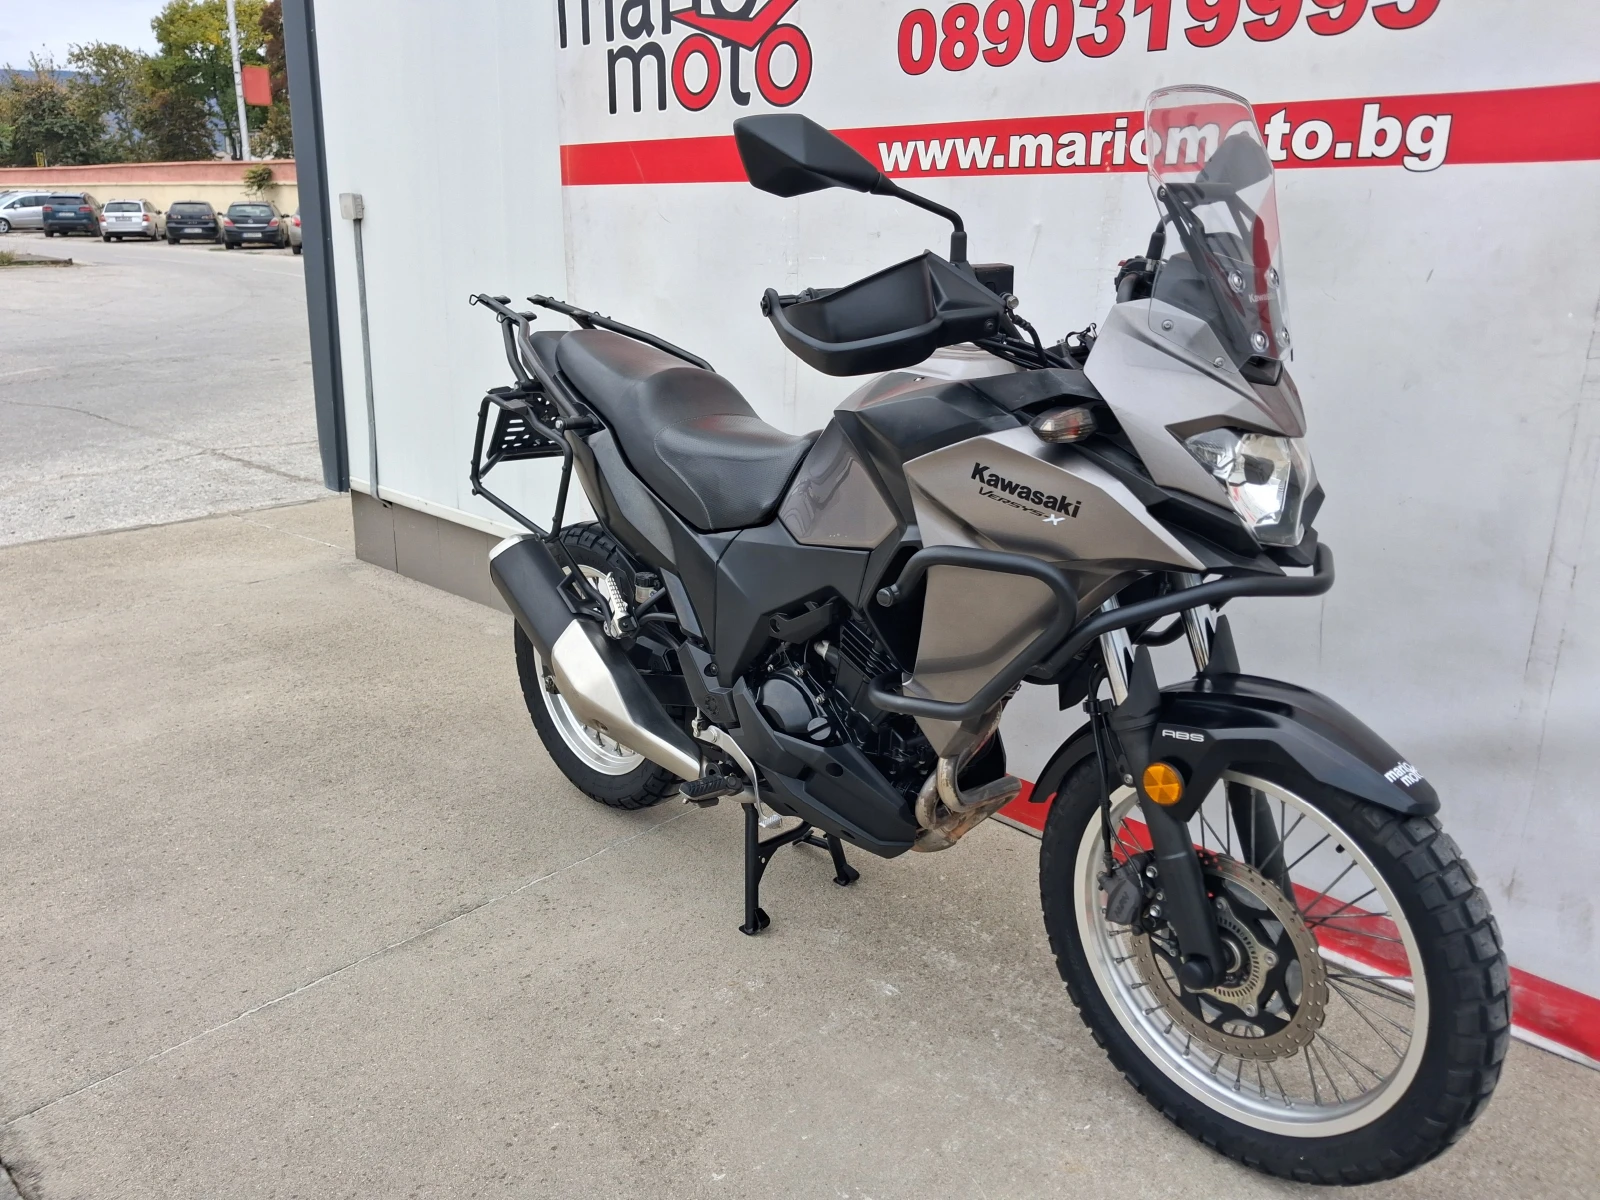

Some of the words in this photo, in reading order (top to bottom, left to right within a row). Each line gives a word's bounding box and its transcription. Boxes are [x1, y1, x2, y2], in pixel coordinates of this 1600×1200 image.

[607, 23, 813, 115] moto
[970, 462, 1082, 518] Kawasaki
[1161, 729, 1205, 743] ABS
